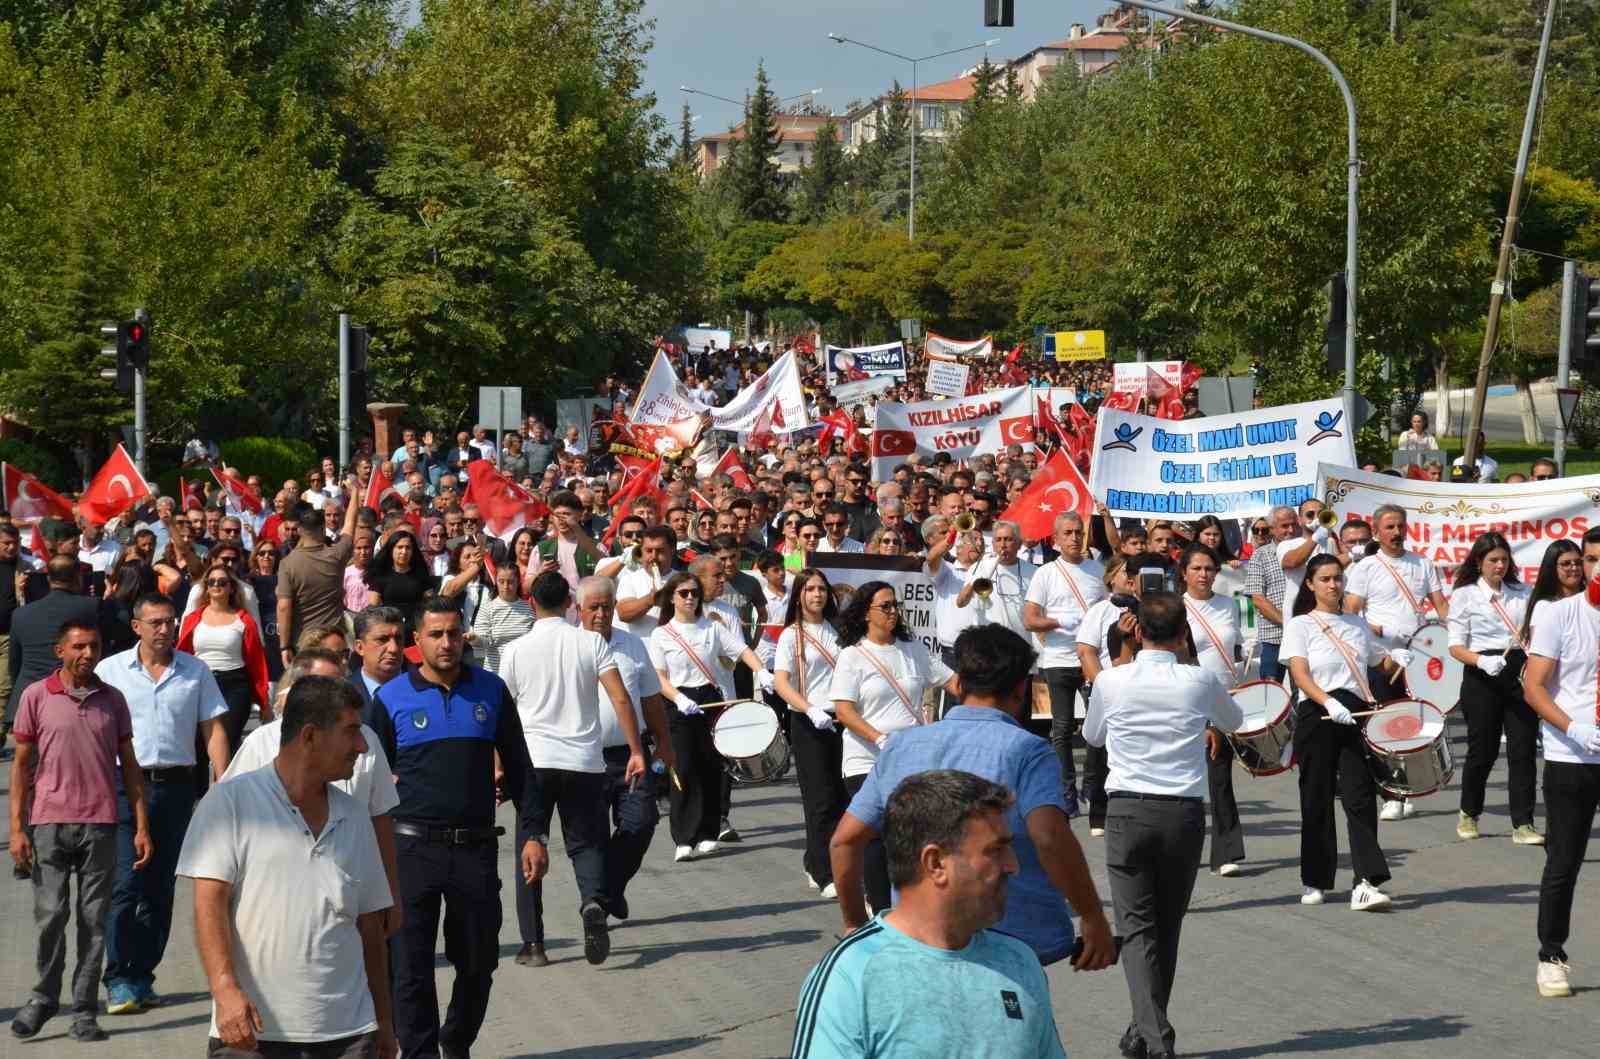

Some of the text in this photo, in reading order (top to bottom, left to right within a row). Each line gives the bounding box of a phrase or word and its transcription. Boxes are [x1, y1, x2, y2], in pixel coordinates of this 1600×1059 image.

[640, 400, 656, 416] 28
[908, 401, 1003, 427] KIZILHİSAR
[934, 427, 981, 450] KÖYÜ
[1152, 418, 1298, 453] ÖZEL MAVİ UMUT
[1160, 453, 1298, 483] ÖZEL EĞİTİM VE
[1411, 546, 1468, 563] KAR
[900, 605, 930, 627] TİM
